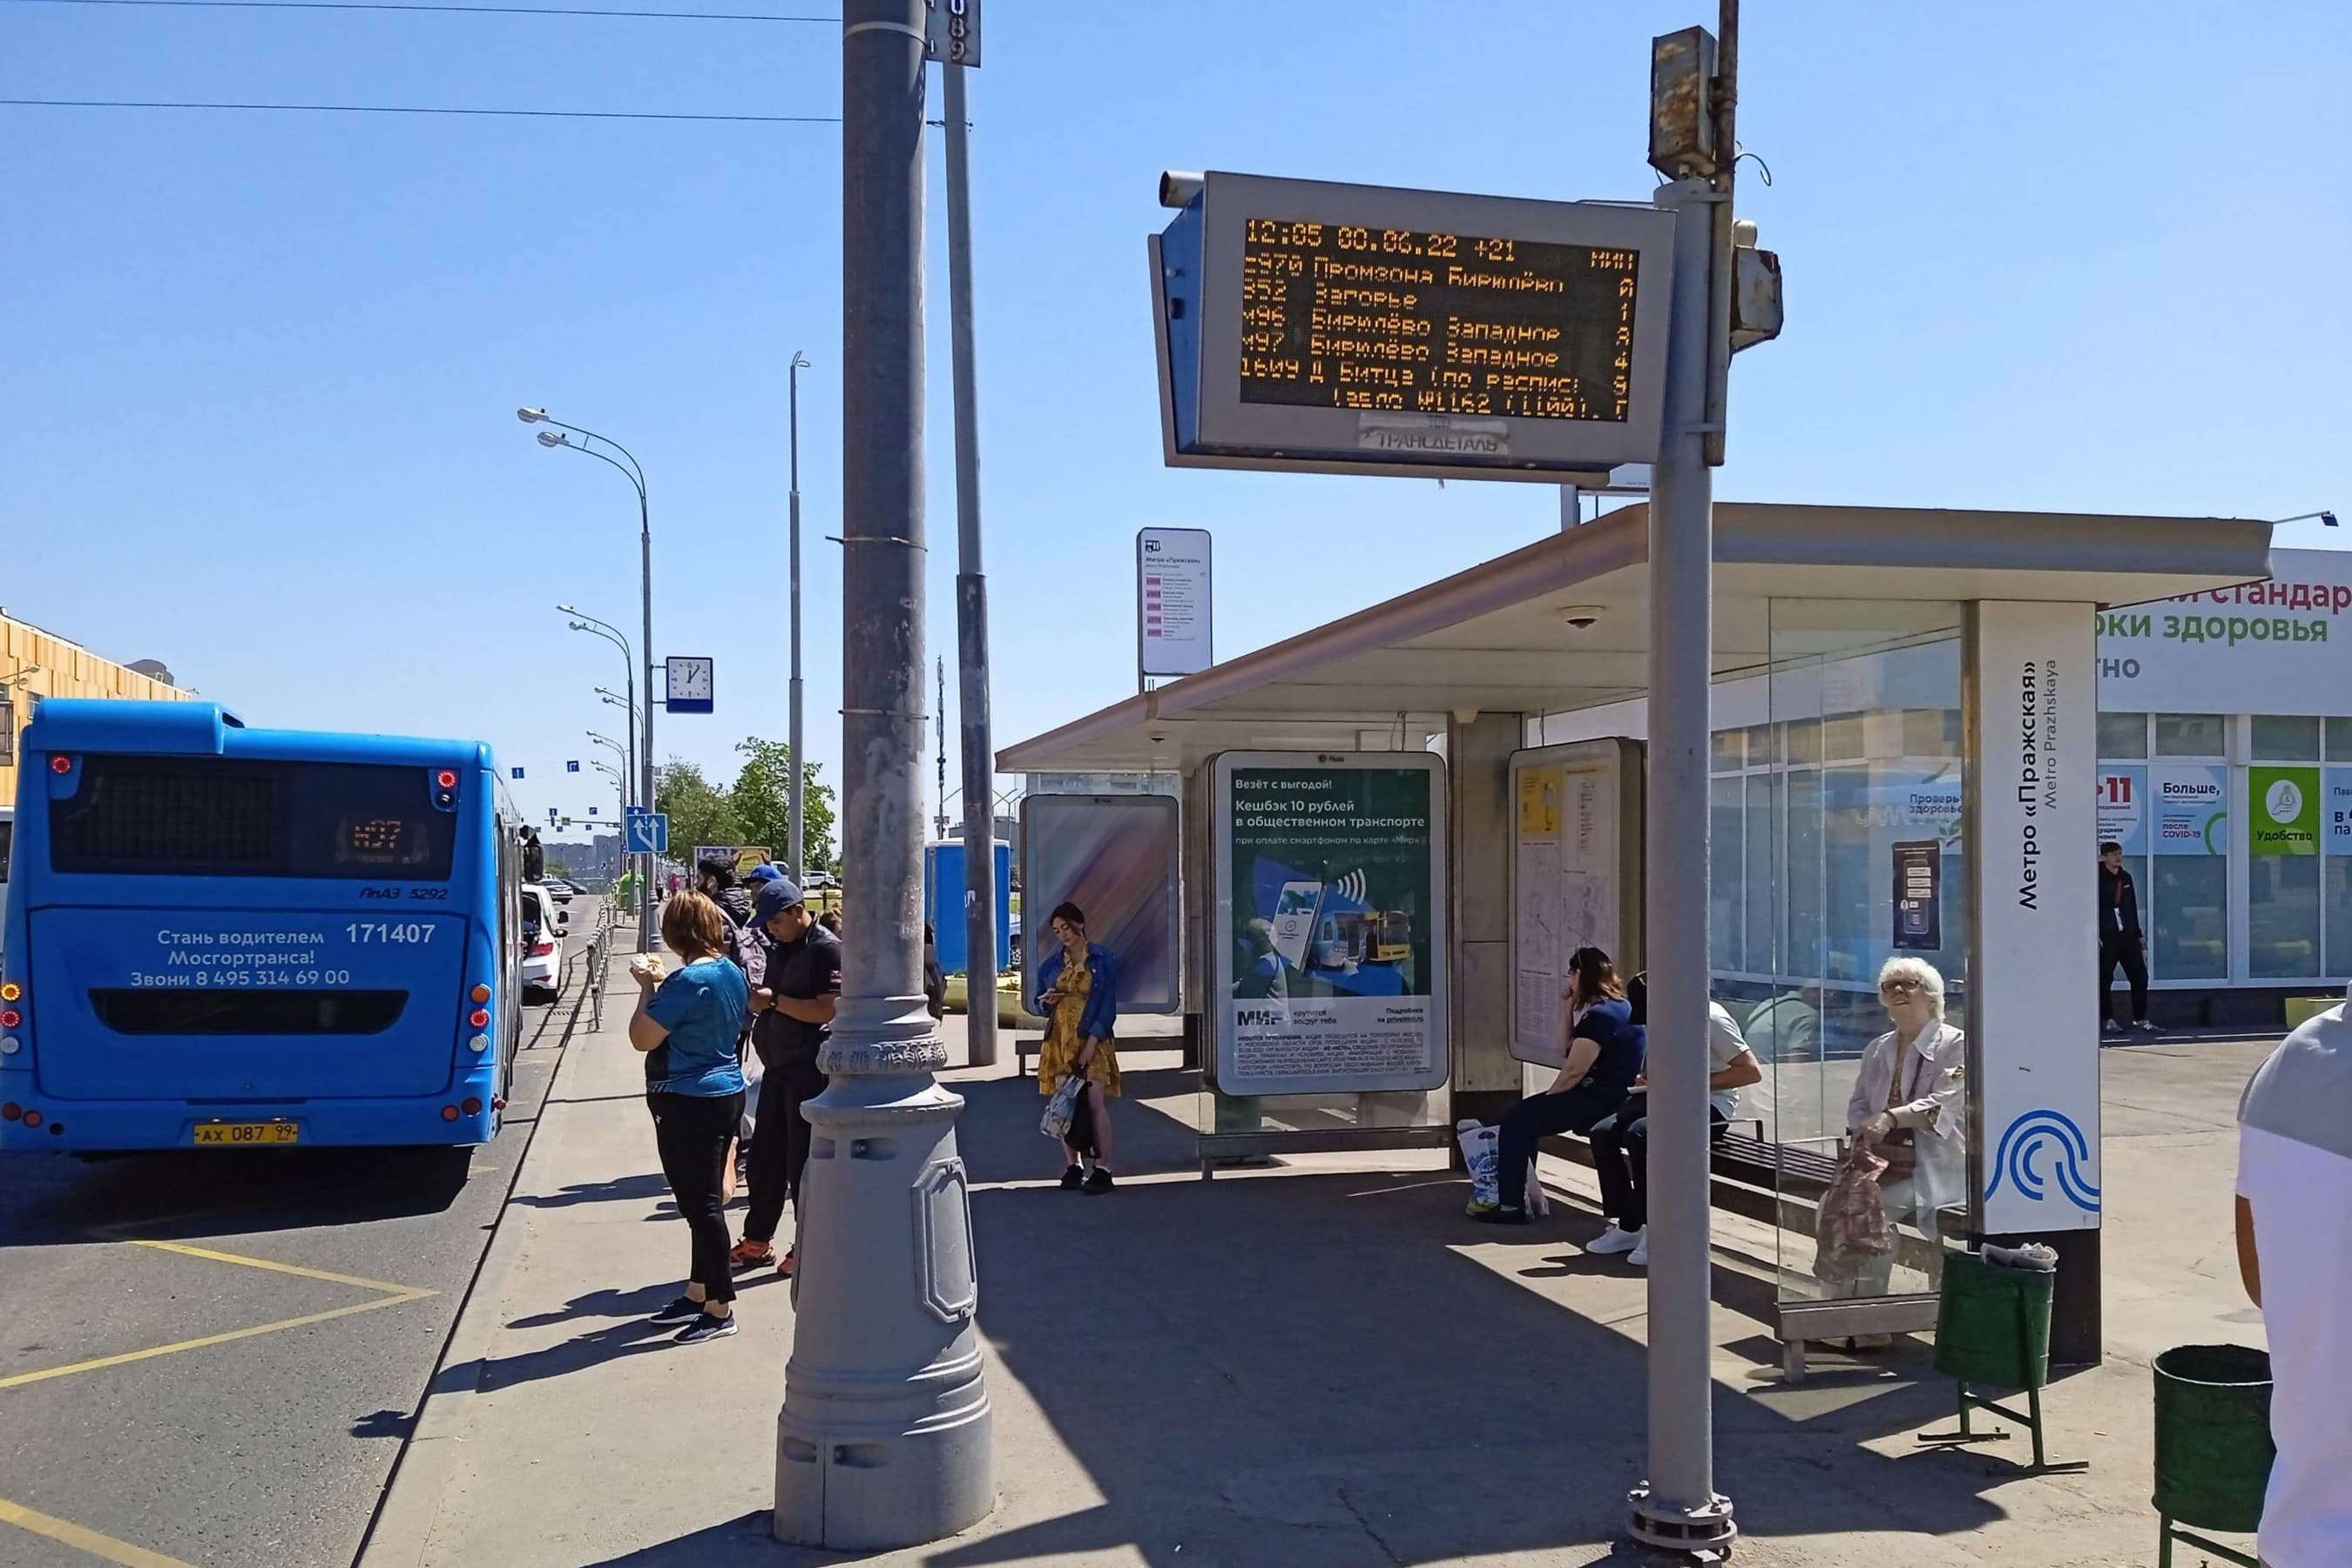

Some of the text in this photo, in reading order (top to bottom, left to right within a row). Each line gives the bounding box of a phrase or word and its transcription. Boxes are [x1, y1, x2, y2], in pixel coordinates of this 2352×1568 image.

[1248, 220, 1322, 247] 12:05
[1475, 239, 1515, 261] +21
[1314, 256, 1434, 285] Промзона
[1315, 281, 1418, 311] Загорье
[1447, 341, 1560, 369] Западное
[1614, 351, 1628, 370] 4
[1340, 362, 1414, 388] Битца
[1377, 432, 1498, 452] ТРАНСДЕТАЛЬ
[2162, 615, 2328, 647] здоровья
[2097, 659, 2141, 679] но
[2044, 659, 2058, 810] Metro Prazhskaya
[1235, 779, 1268, 789] Везёт
[1281, 780, 1332, 790] выгодой!
[2018, 661, 2040, 910] Метро «Пражская»
[2163, 782, 2220, 796] Больше,
[1235, 800, 1355, 814] Кешбэк 10 рублей
[1909, 794, 1963, 805] Проверь
[1247, 816, 1346, 828] общественном
[1349, 818, 1425, 828] транспорте
[1289, 835, 1348, 846] смартфоном
[2256, 829, 2313, 842] Удобство
[409, 888, 449, 900] 5292
[157, 929, 324, 946] Стань водителем
[346, 923, 436, 944] 171407
[167, 950, 314, 969] Мосгортранса!
[131, 970, 349, 986] Звони 8 495 314 69 00
[232, 1126, 265, 1141] 087
[274, 1124, 293, 1136] 99
